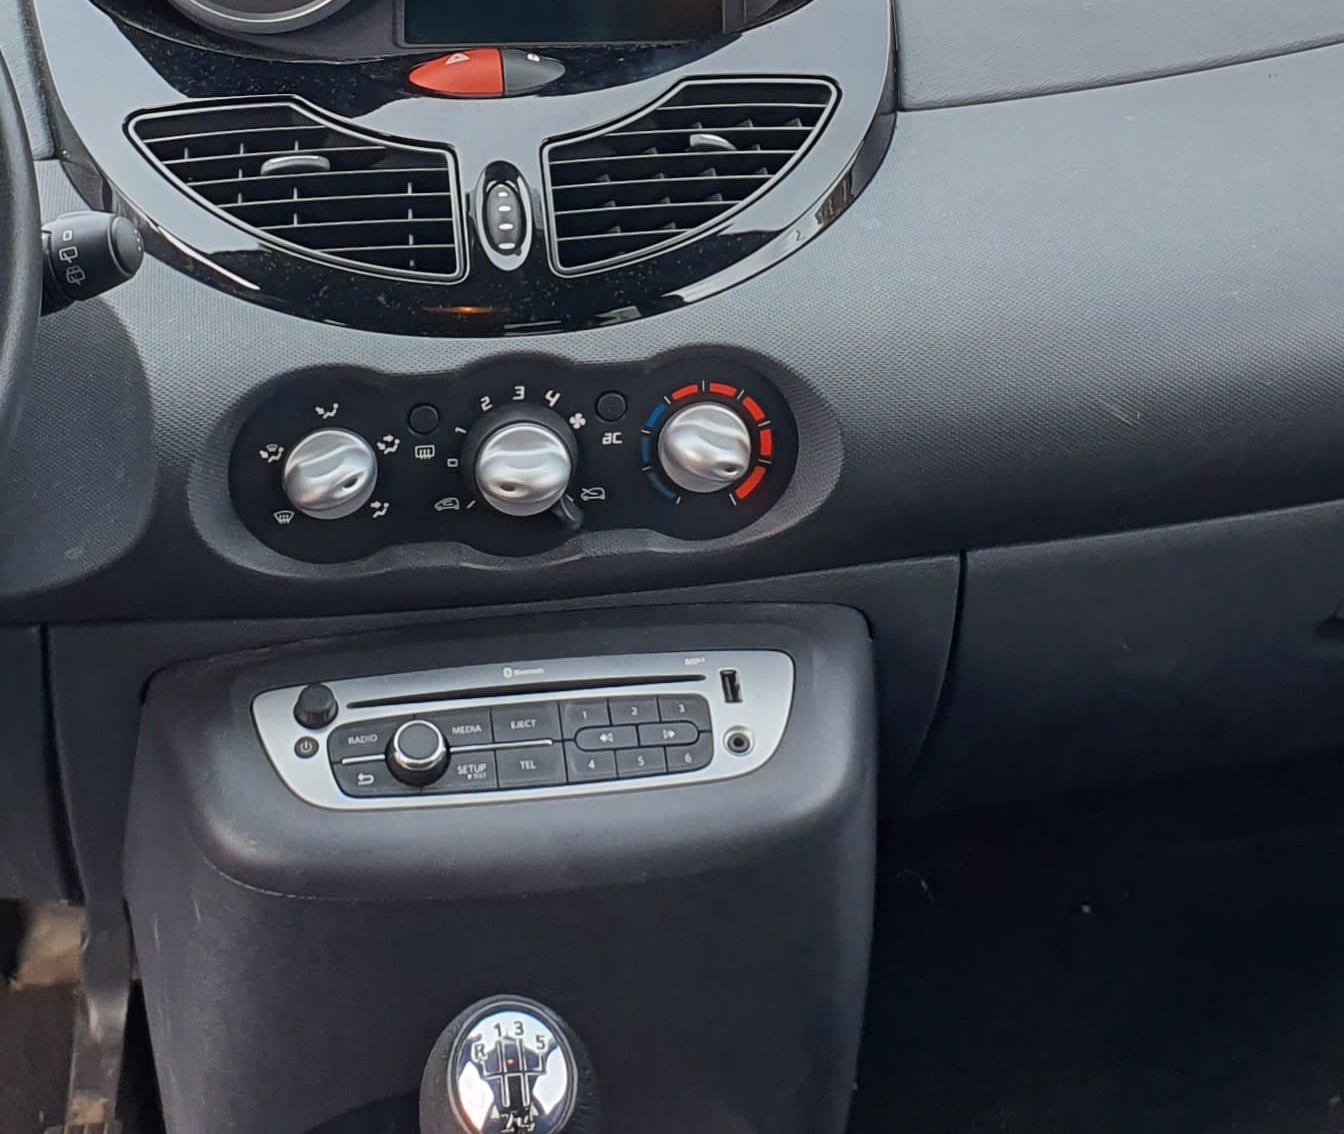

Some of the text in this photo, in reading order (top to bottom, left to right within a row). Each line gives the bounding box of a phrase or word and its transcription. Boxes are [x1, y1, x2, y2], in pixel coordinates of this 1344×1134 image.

[480, 396, 493, 411] 2
[512, 385, 525, 400] 3
[544, 389, 561, 407] 4
[582, 704, 685, 719] 1 2 3
[451, 724, 482, 735] MEDIA
[510, 719, 536, 729] EJECT
[348, 733, 378, 745] RADIO
[519, 760, 536, 770] TEL
[588, 753, 692, 769] 4 5 6
[457, 763, 487, 775] SETUP
[473, 1020, 546, 1059] R 1 3 5
